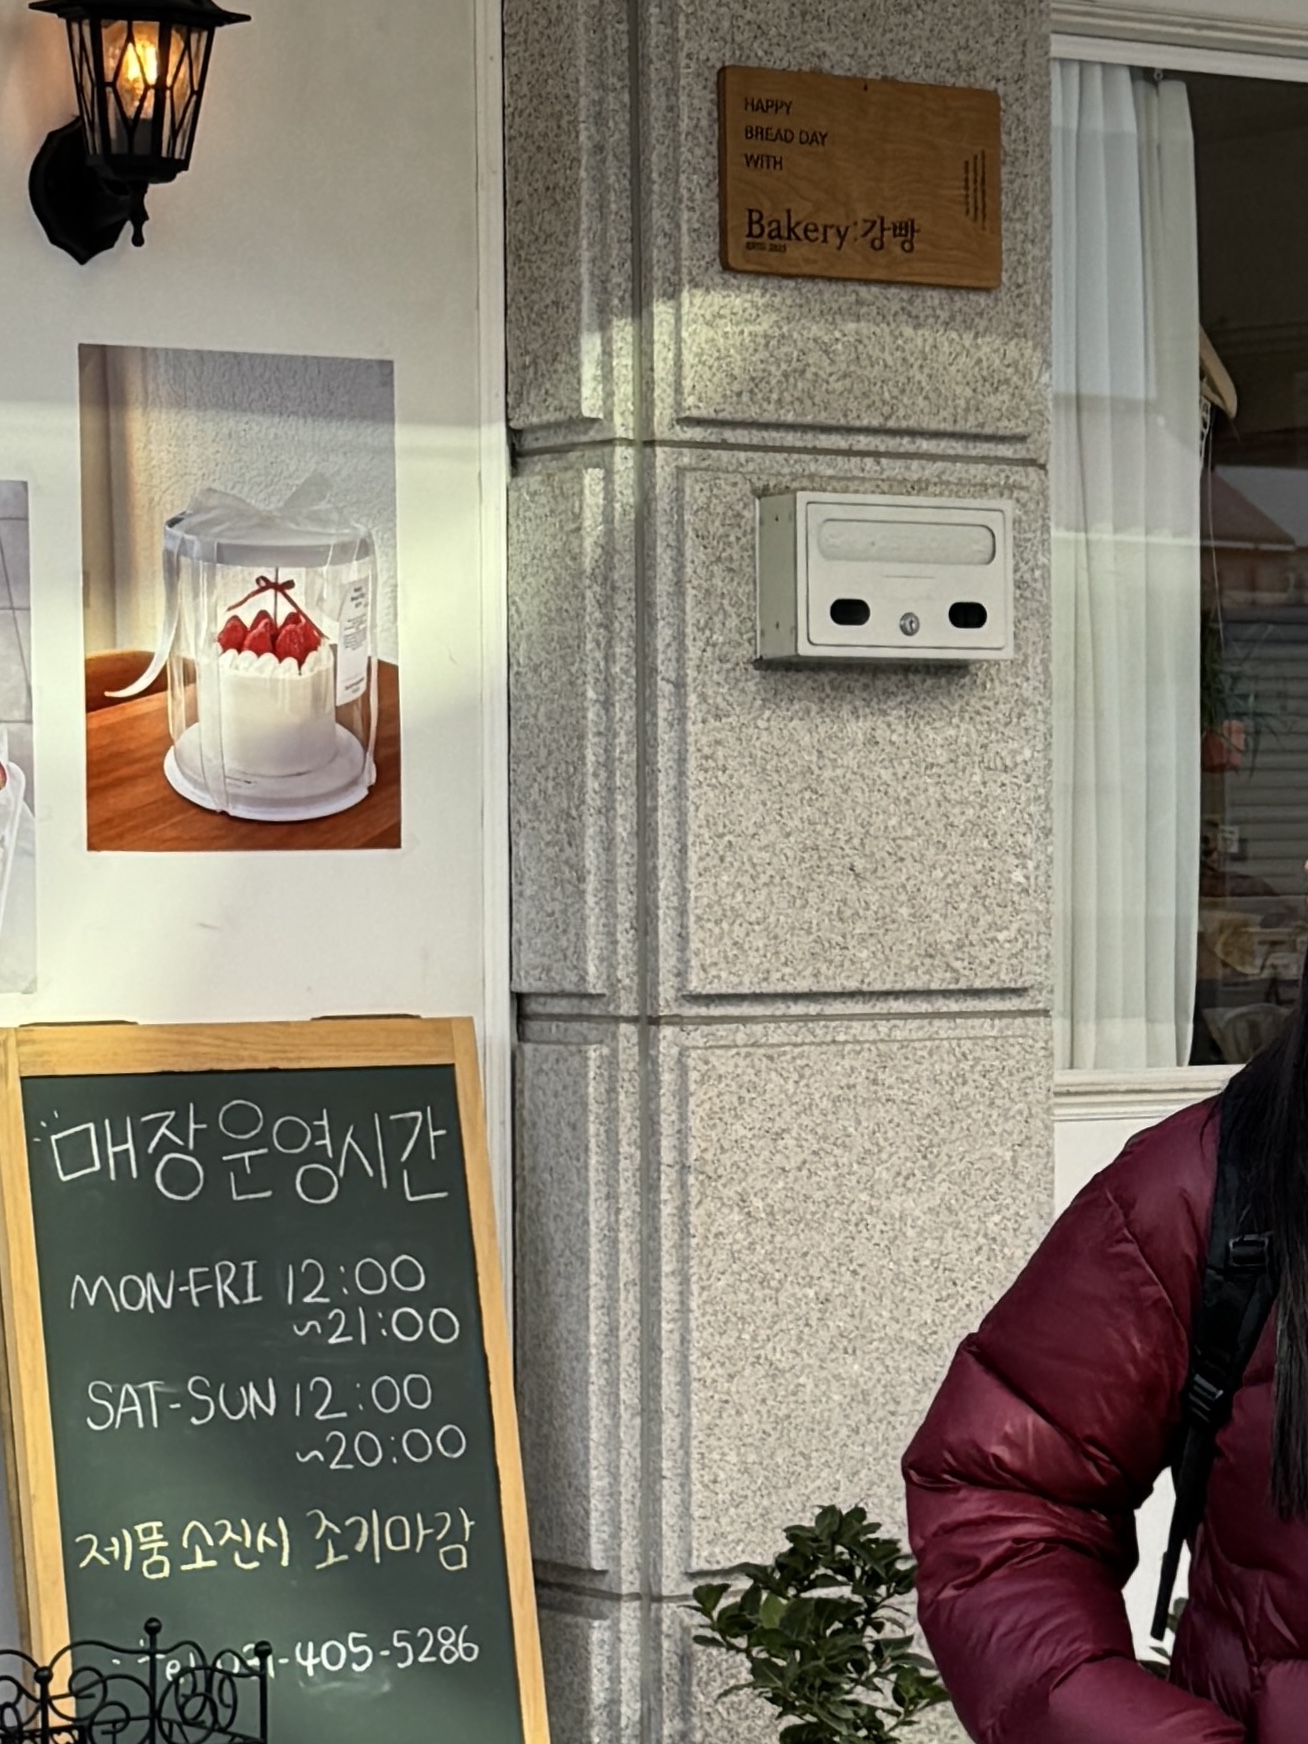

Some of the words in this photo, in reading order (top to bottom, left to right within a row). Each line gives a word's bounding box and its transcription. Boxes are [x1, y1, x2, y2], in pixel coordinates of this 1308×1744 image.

[745, 97, 793, 115] HAPPY
[745, 125, 795, 144] BREAD
[799, 129, 828, 147] DAY
[744, 153, 783, 171] WITH
[70, 1259, 264, 1314] MON-FRI
[286, 1254, 426, 1306] 12:00
[86, 1376, 278, 1431] SAT-SUN
[295, 1373, 433, 1421] 12:00
[306, 1506, 476, 1573] 조기마감
